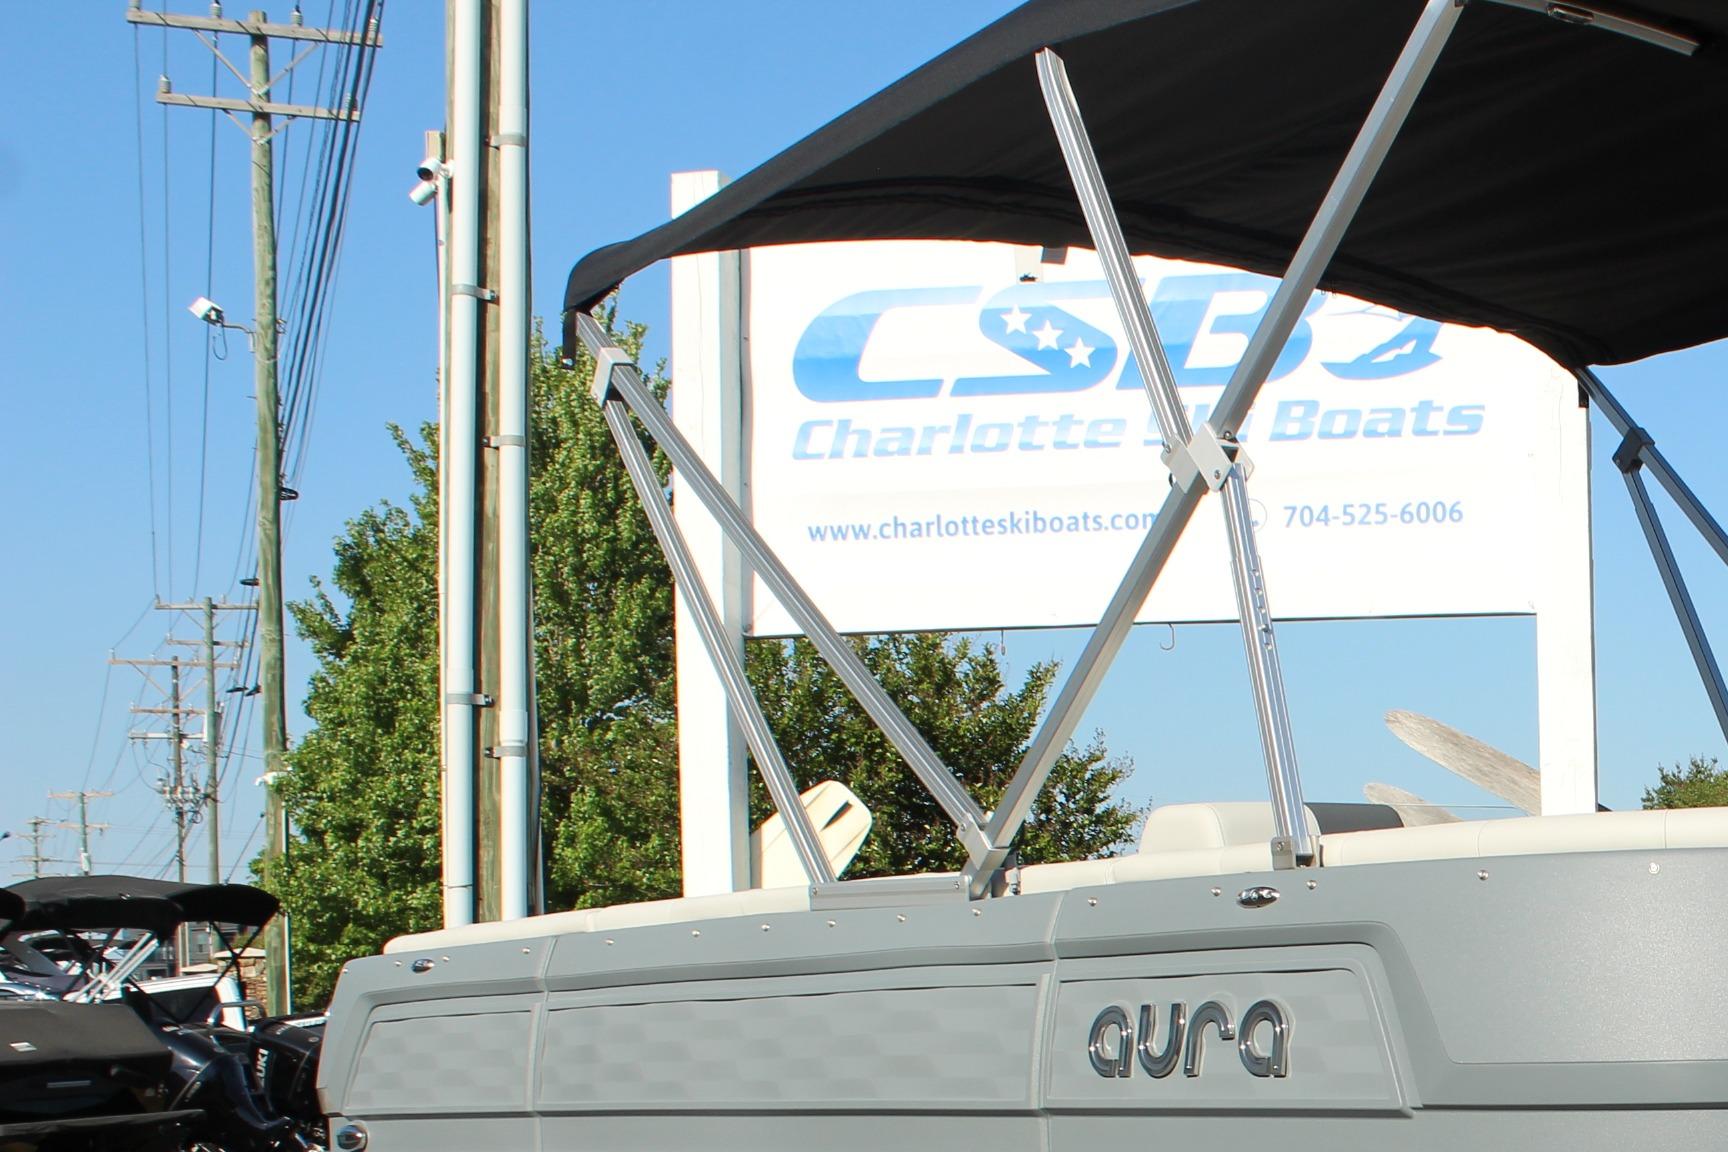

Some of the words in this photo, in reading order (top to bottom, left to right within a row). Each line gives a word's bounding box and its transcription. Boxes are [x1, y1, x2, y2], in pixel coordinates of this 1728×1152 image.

[792, 413, 1126, 461] Charlotte
[1268, 400, 1486, 441] Boats
[1283, 501, 1464, 528] 704-525-6006
[1088, 999, 1290, 1079] aura
